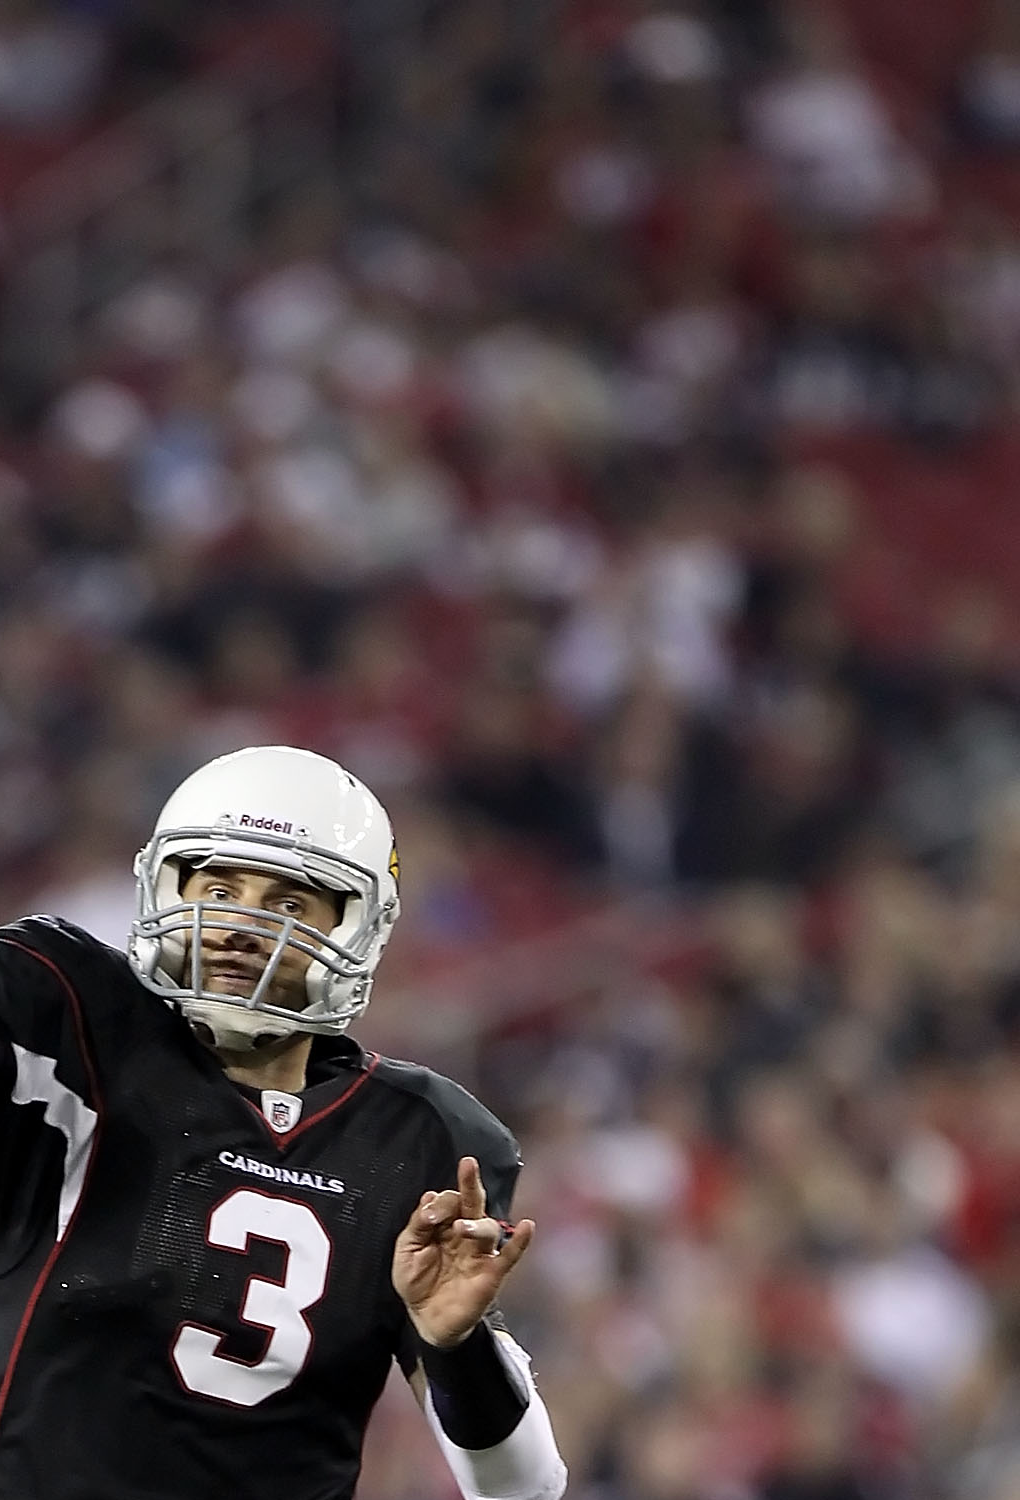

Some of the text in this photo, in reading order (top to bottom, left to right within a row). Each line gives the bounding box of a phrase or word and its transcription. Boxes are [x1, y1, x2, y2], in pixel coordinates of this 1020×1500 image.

[239, 814, 293, 834] Riddell
[218, 1151, 345, 1194] CARDINALS
[172, 1187, 332, 1408] 3
